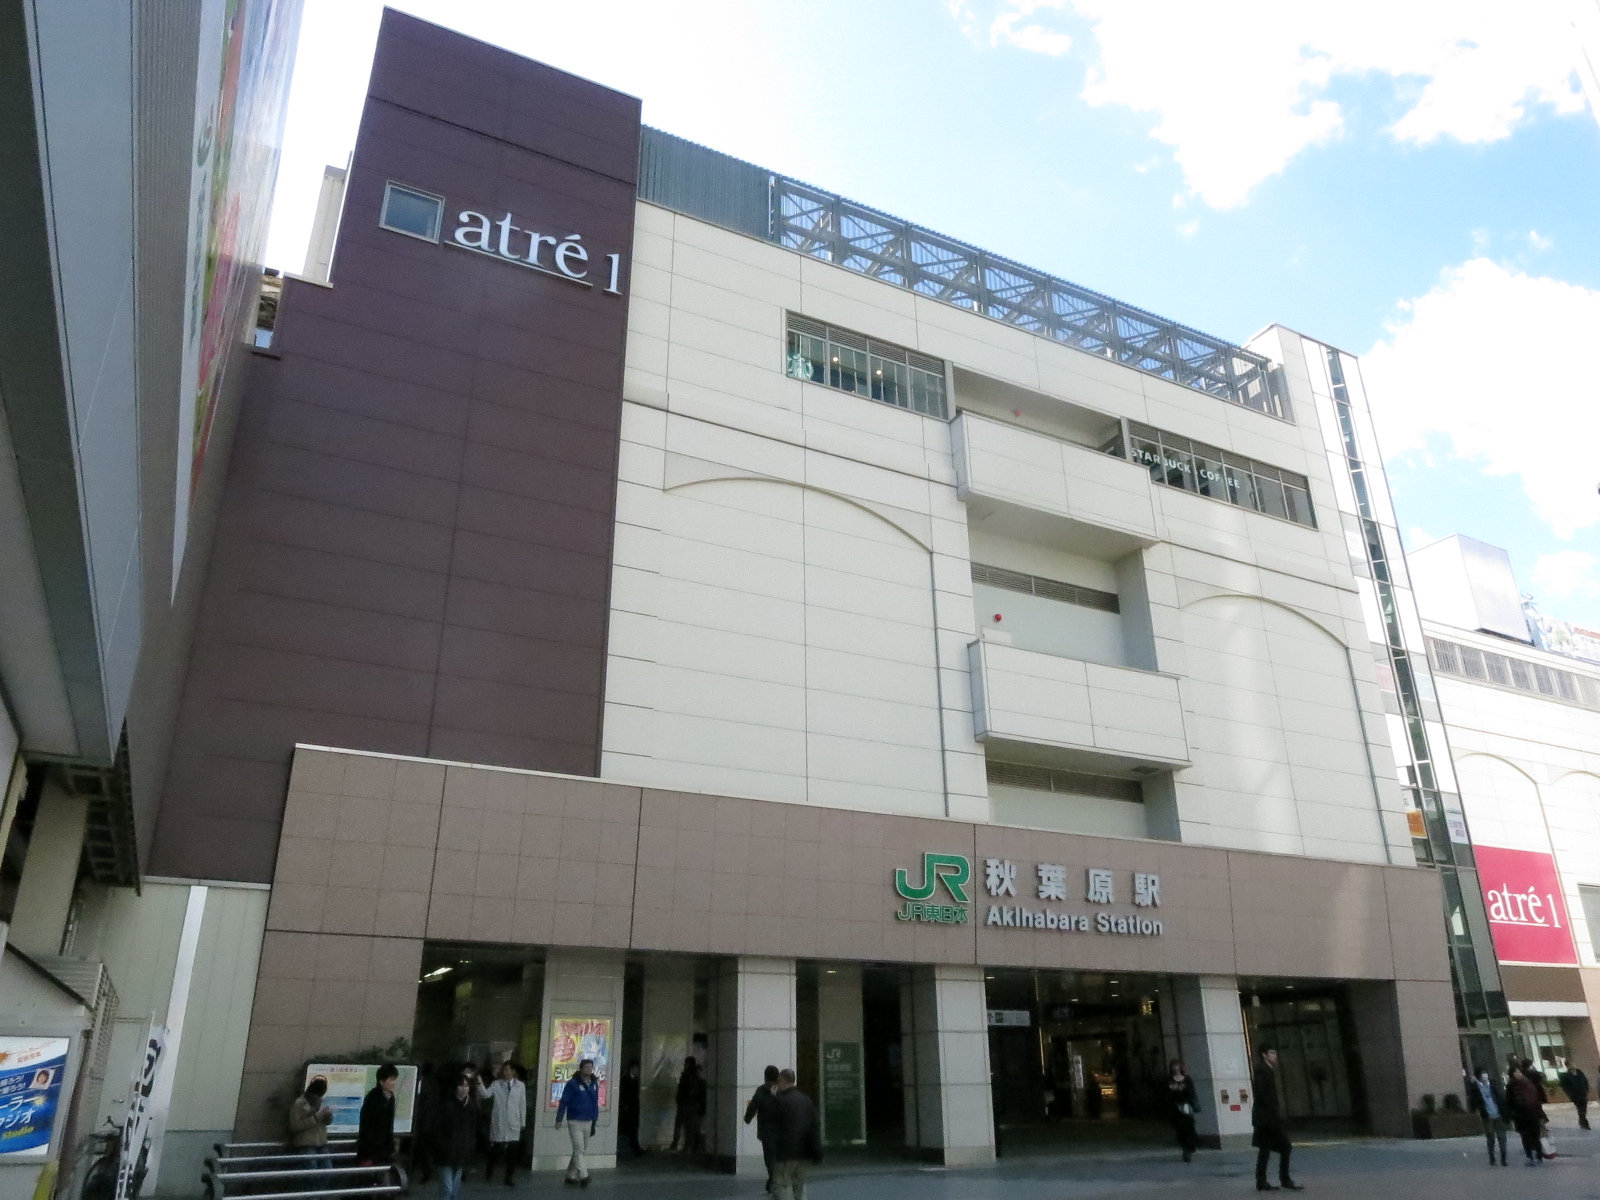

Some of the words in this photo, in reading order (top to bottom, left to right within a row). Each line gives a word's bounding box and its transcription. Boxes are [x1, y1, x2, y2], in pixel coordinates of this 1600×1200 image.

[454, 210, 589, 279] atré
[603, 253, 622, 295] 1
[1131, 448, 1196, 476] STARBUCK
[1200, 469, 1241, 488] COFEE
[895, 852, 971, 903] JR
[985, 858, 1161, 907] 秋葉原駅
[897, 902, 969, 924] JR東日本
[986, 905, 1089, 932] Akihabara
[1097, 911, 1163, 936] Station
[1487, 883, 1546, 924] atré
[1546, 894, 1562, 929] 1
